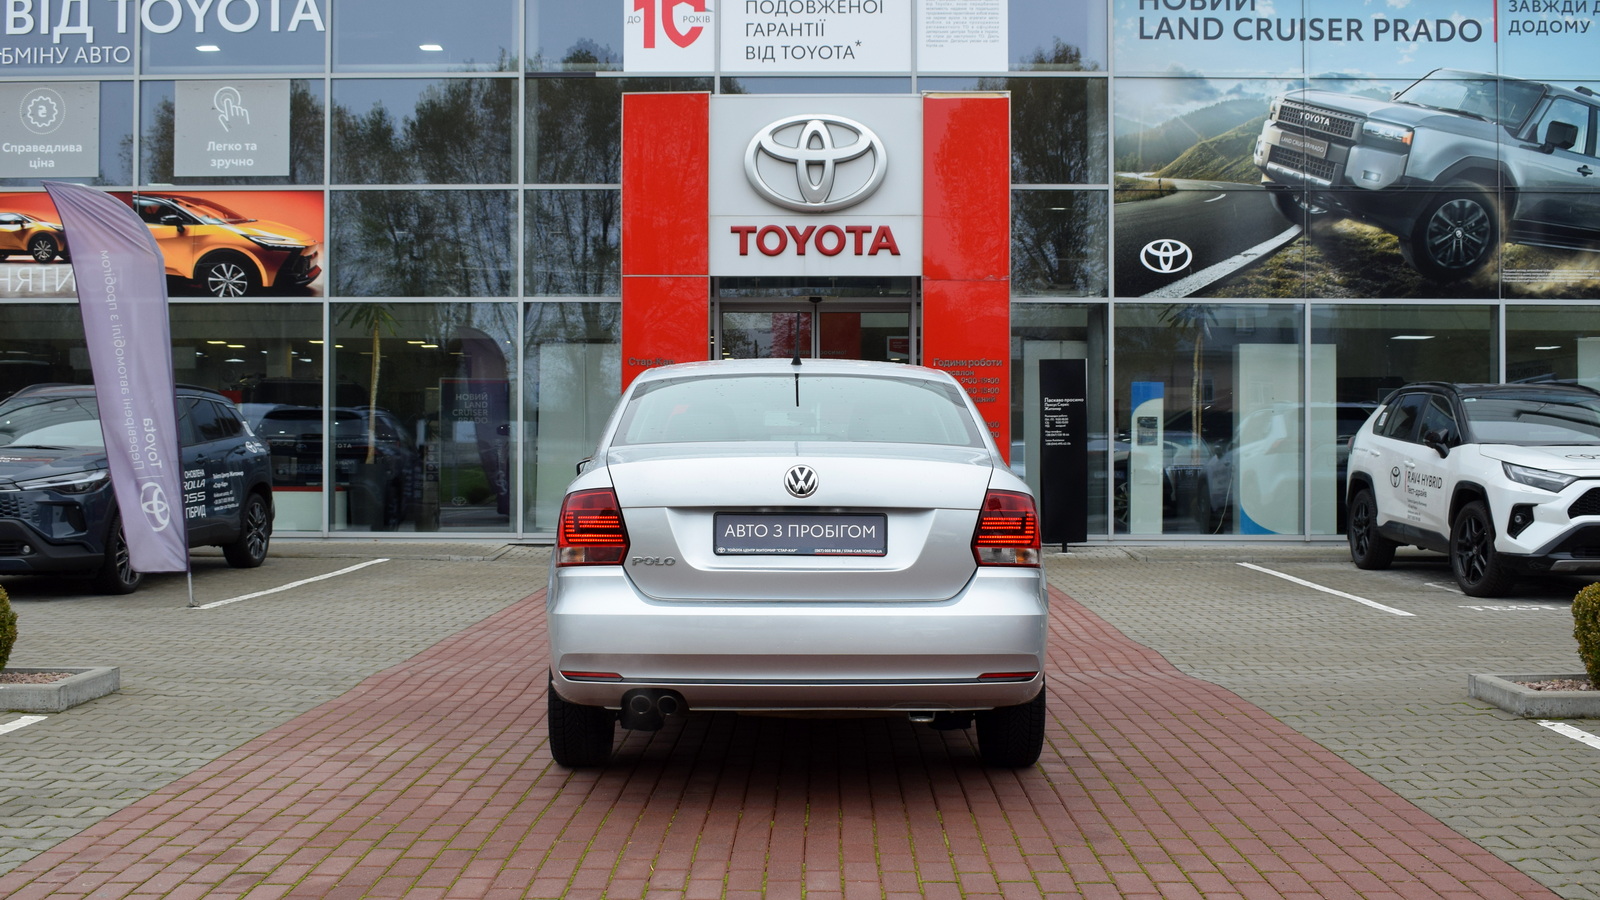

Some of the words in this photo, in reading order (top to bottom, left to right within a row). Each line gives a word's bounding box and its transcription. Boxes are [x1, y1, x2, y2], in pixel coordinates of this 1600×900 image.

[1509, 0, 1587, 16] ЗАВЖДИ
[6, 0, 95, 44] ВІД
[107, 0, 327, 34] TOYOTA
[627, 15, 641, 25] ДО
[682, 15, 711, 24] РОКІВ
[745, 19, 826, 37] ГАРАНТІЇ
[1139, 17, 1224, 40] LAND
[1233, 17, 1363, 42] CRUISER
[1374, 18, 1482, 42] PRADO
[1508, 20, 1591, 36] ДОДОМУ
[0, 47, 69, 64] БМІНУ
[74, 46, 131, 63] АВТО
[745, 45, 776, 63] ВІД
[1300, 112, 1330, 126] TOYOTA
[2, 143, 83, 155] Справедлива
[206, 141, 241, 154] Легко
[242, 143, 258, 152] та
[29, 158, 55, 170] ціна
[210, 157, 254, 169] зручно
[730, 224, 901, 257] TOYOTA
[933, 358, 966, 367] Години
[968, 358, 1002, 368] роботи
[455, 392, 488, 400] НОВИЙ
[464, 401, 488, 409] LAND
[1407, 470, 1421, 483] RAV4
[1421, 473, 1443, 489] HYBRID
[724, 524, 768, 537] АВТО
[788, 525, 876, 538] ПРОБІГОМ
[632, 556, 676, 566] POLO
